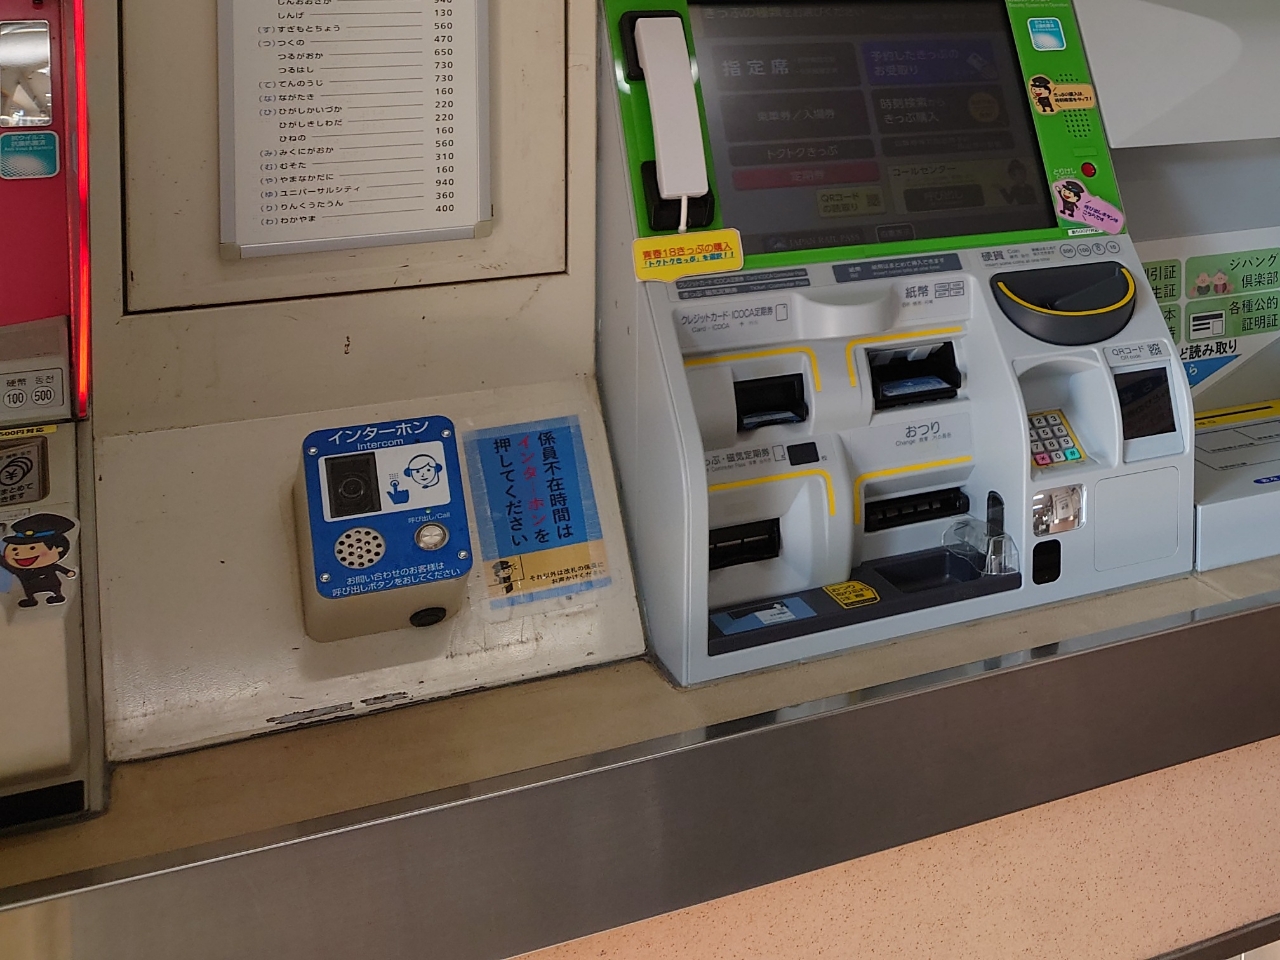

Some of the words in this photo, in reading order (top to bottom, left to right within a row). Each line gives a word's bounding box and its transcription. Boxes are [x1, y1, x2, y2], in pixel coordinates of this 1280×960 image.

[278, 52, 323, 60] つるがおか
[278, 66, 314, 74] つるはし
[721, 58, 790, 78] 指定席
[279, 134, 306, 142] ひねの
[820, 192, 859, 203] QRコード
[642, 242, 732, 260] 青春18きっぷの購入
[981, 250, 1004, 262] 硬貨
[1229, 253, 1279, 272] ジパング
[1242, 271, 1279, 288] 倶楽部
[905, 286, 929, 298] 紙幣
[1229, 296, 1279, 315] 各種公的
[1242, 313, 1278, 331] 証明証
[1112, 346, 1144, 356] QRコード
[7, 392, 24, 405] 100
[34, 389, 51, 402] 500
[328, 421, 428, 445] インターホン
[905, 422, 940, 438] おつり
[357, 438, 404, 450] Intercom
[494, 438, 528, 546] 押してください
[518, 434, 549, 543] インターホンを
[537, 431, 574, 539] 係員不在時間は
[346, 562, 444, 585] お問い合わせのお客様は
[332, 568, 460, 597] 呼び出しボタンをおしてください
